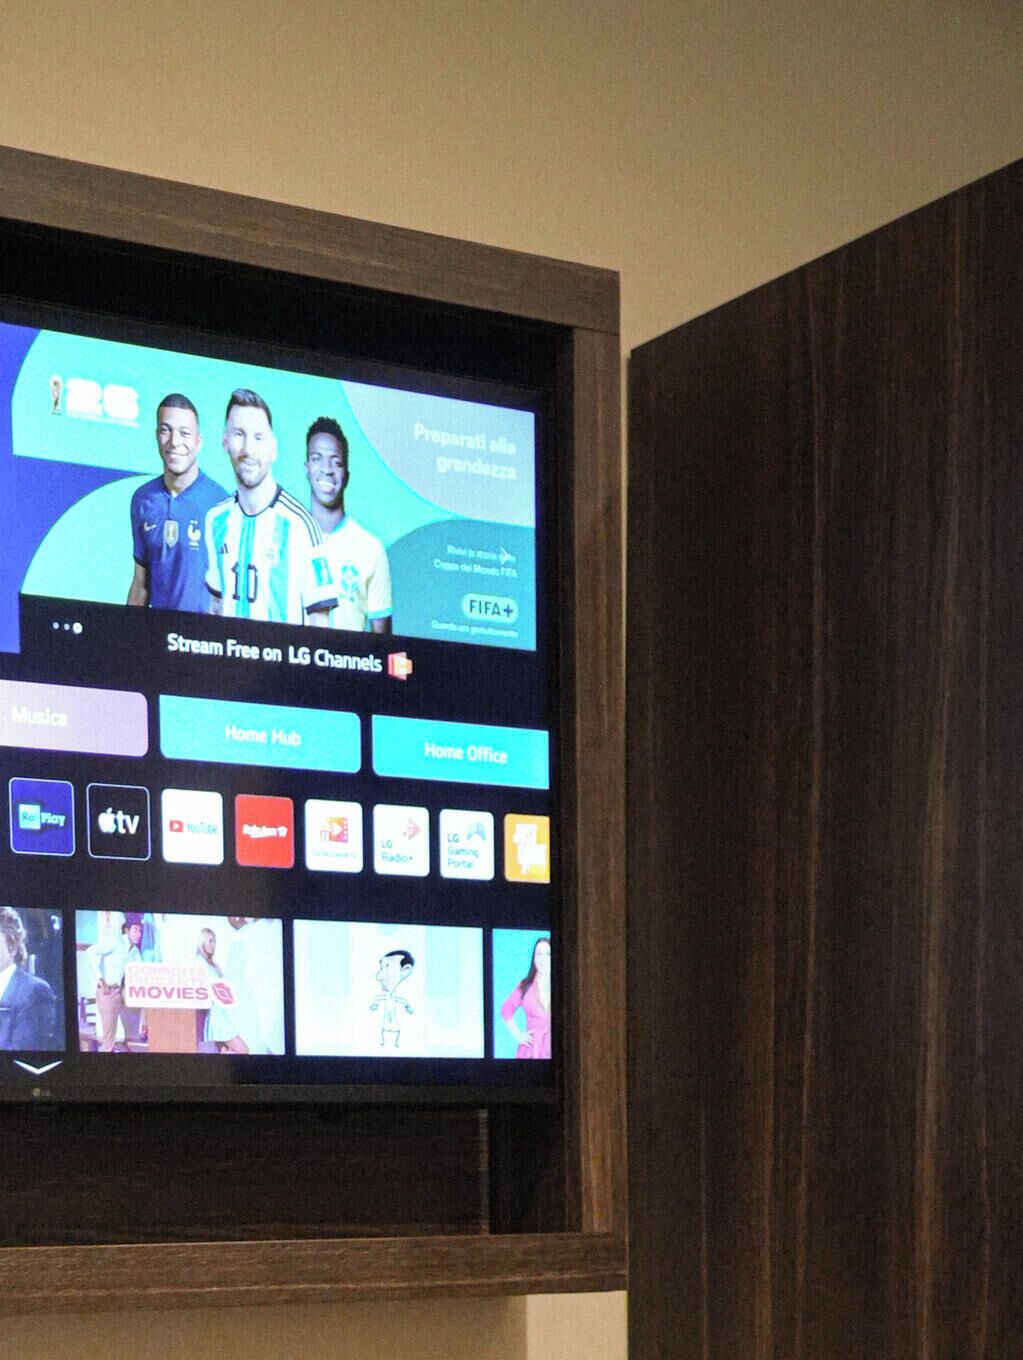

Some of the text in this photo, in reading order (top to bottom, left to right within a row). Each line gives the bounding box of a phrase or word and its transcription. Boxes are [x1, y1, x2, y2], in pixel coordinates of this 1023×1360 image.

[414, 423, 517, 455] Preparati alla
[436, 456, 517, 480] grandezza
[231, 561, 258, 603] 10
[469, 599, 514, 618] FIFA+
[167, 633, 383, 673] Stream Free on LG Channels
[11, 705, 68, 727] Musica
[225, 724, 302, 747] Home Hub
[424, 741, 509, 765] Home Office
[381, 839, 393, 850] LG
[447, 833, 460, 844] LG
[447, 846, 480, 859] Gaming
[128, 985, 209, 1001] MOVIES
